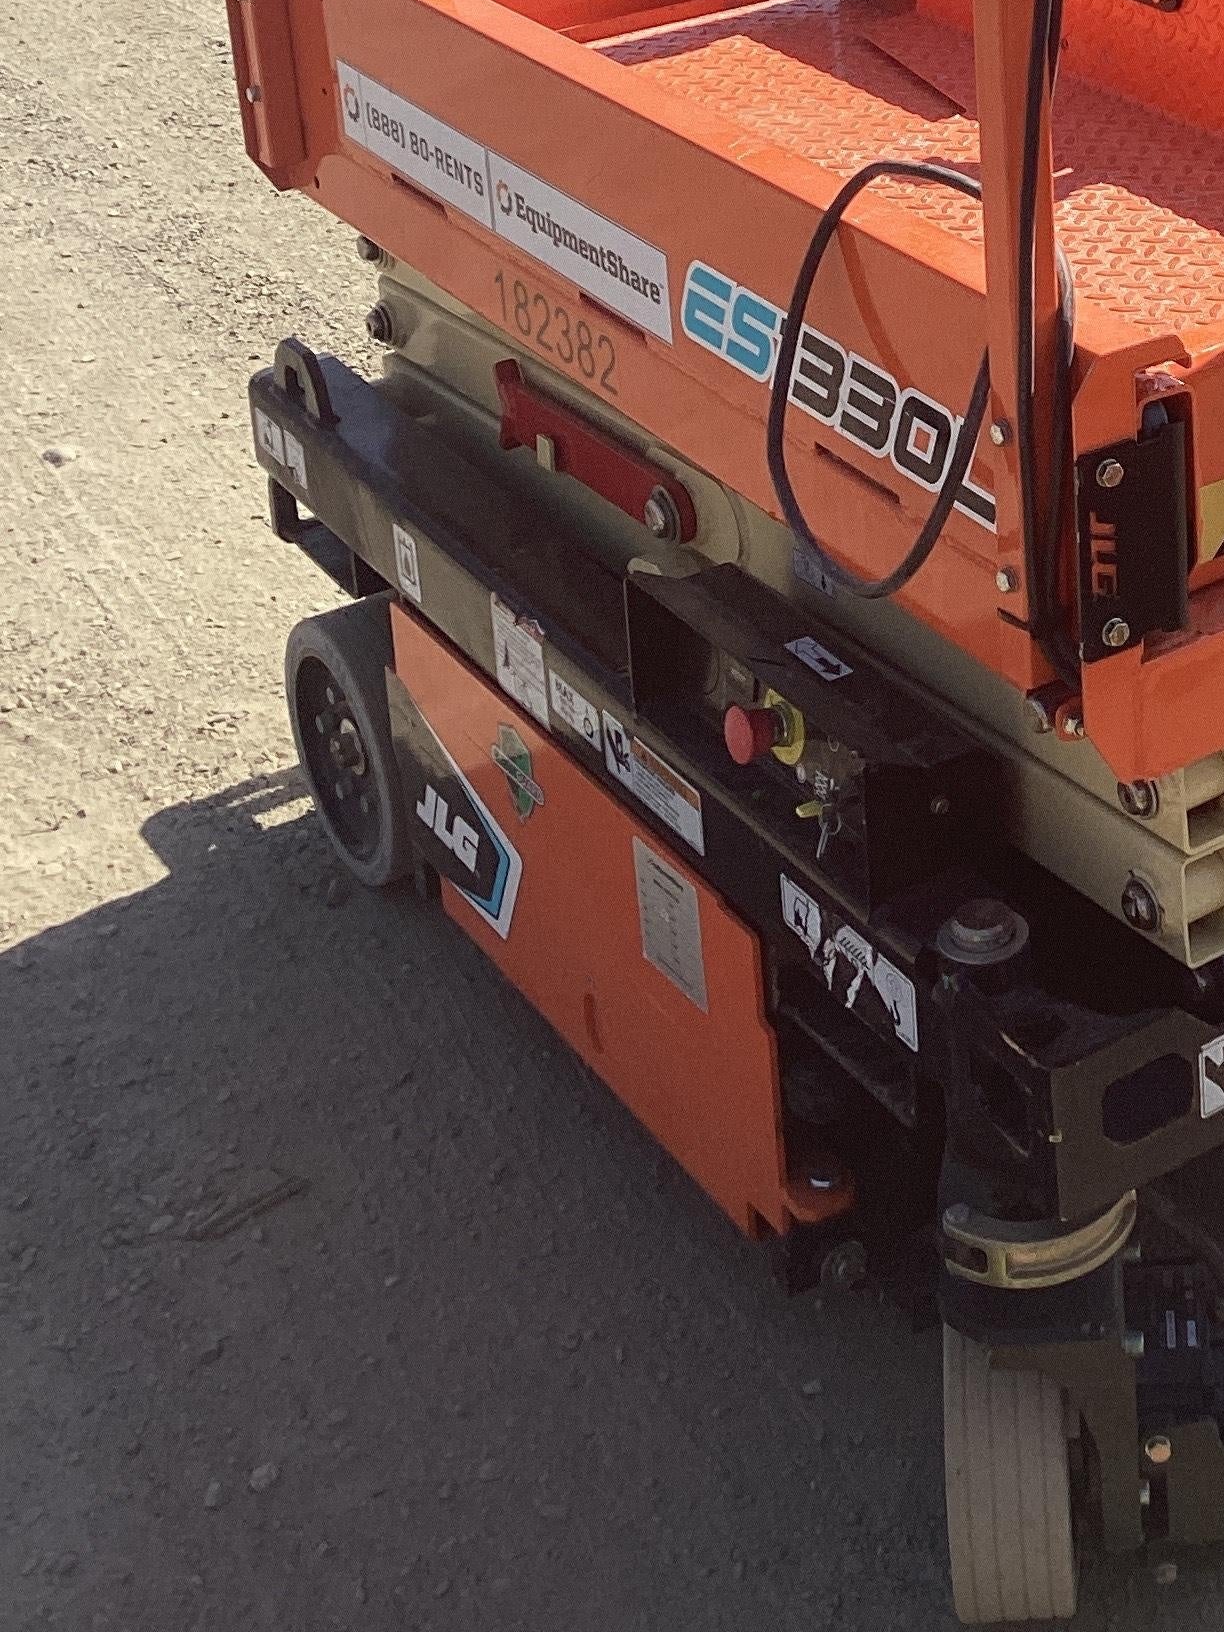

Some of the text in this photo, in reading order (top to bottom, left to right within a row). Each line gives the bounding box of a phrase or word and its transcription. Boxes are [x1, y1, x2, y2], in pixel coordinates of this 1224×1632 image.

[365, 101, 663, 306] (888) 80-RENTS EquipmentShare
[494, 269, 619, 396] 182382
[415, 783, 480, 874] JLG
